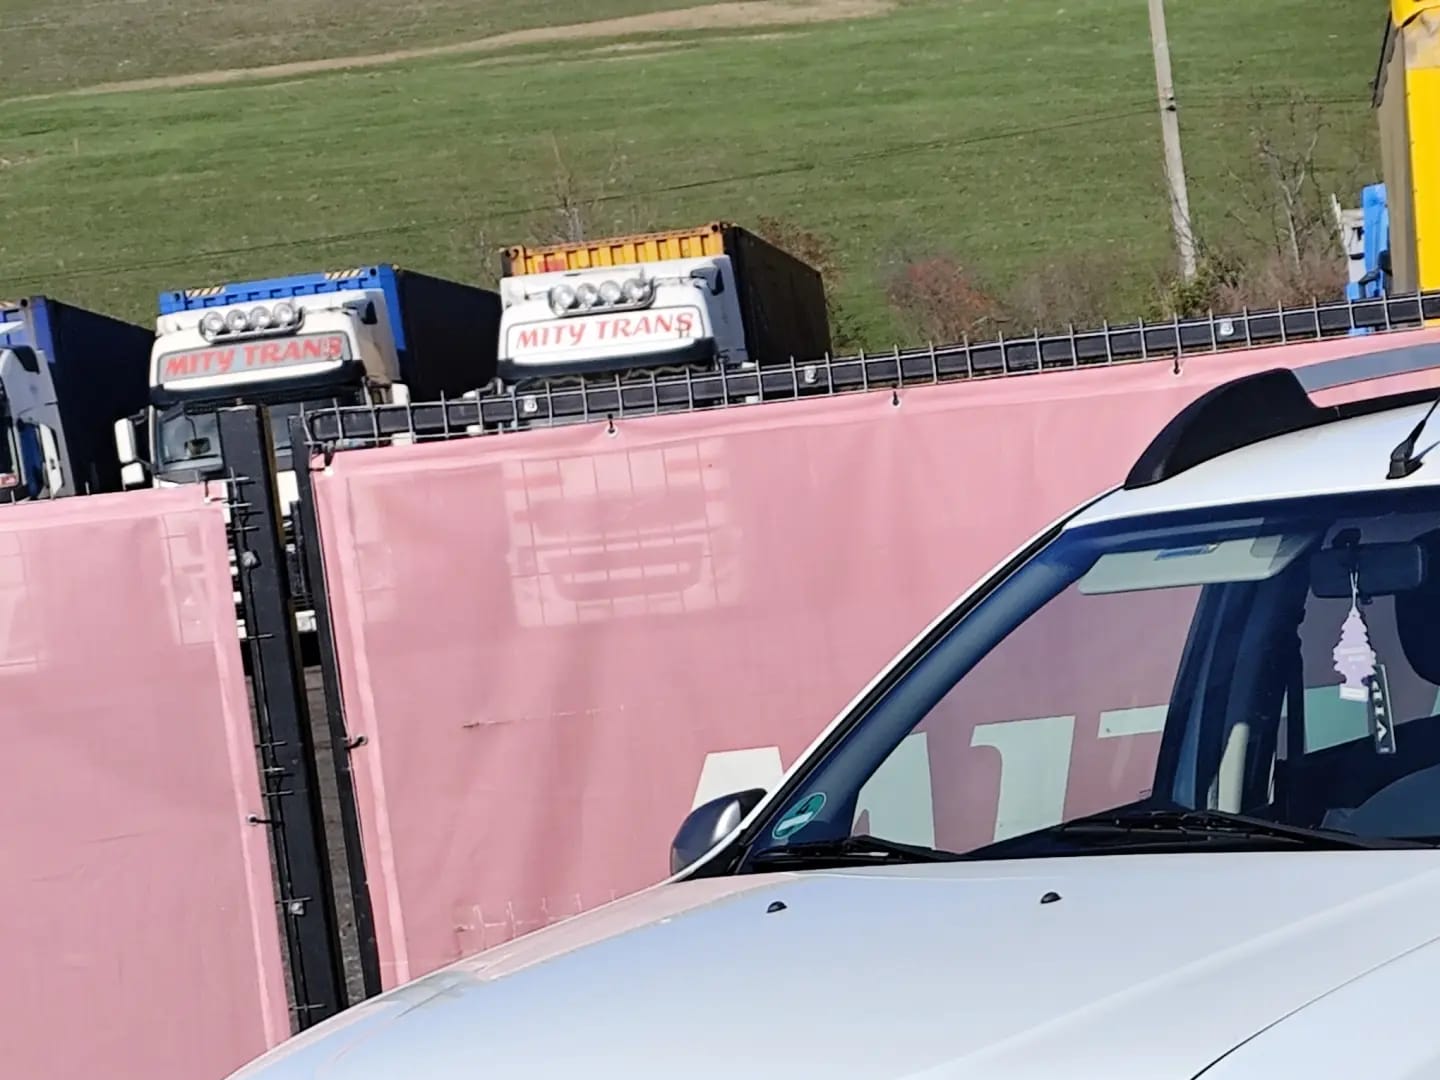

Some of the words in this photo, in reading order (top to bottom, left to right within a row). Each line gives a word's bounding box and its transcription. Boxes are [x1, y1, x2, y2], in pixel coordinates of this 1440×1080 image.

[516, 321, 587, 349] MITY
[594, 312, 695, 340] TRANS
[165, 347, 236, 376] MITY
[243, 336, 343, 366] TRANS
